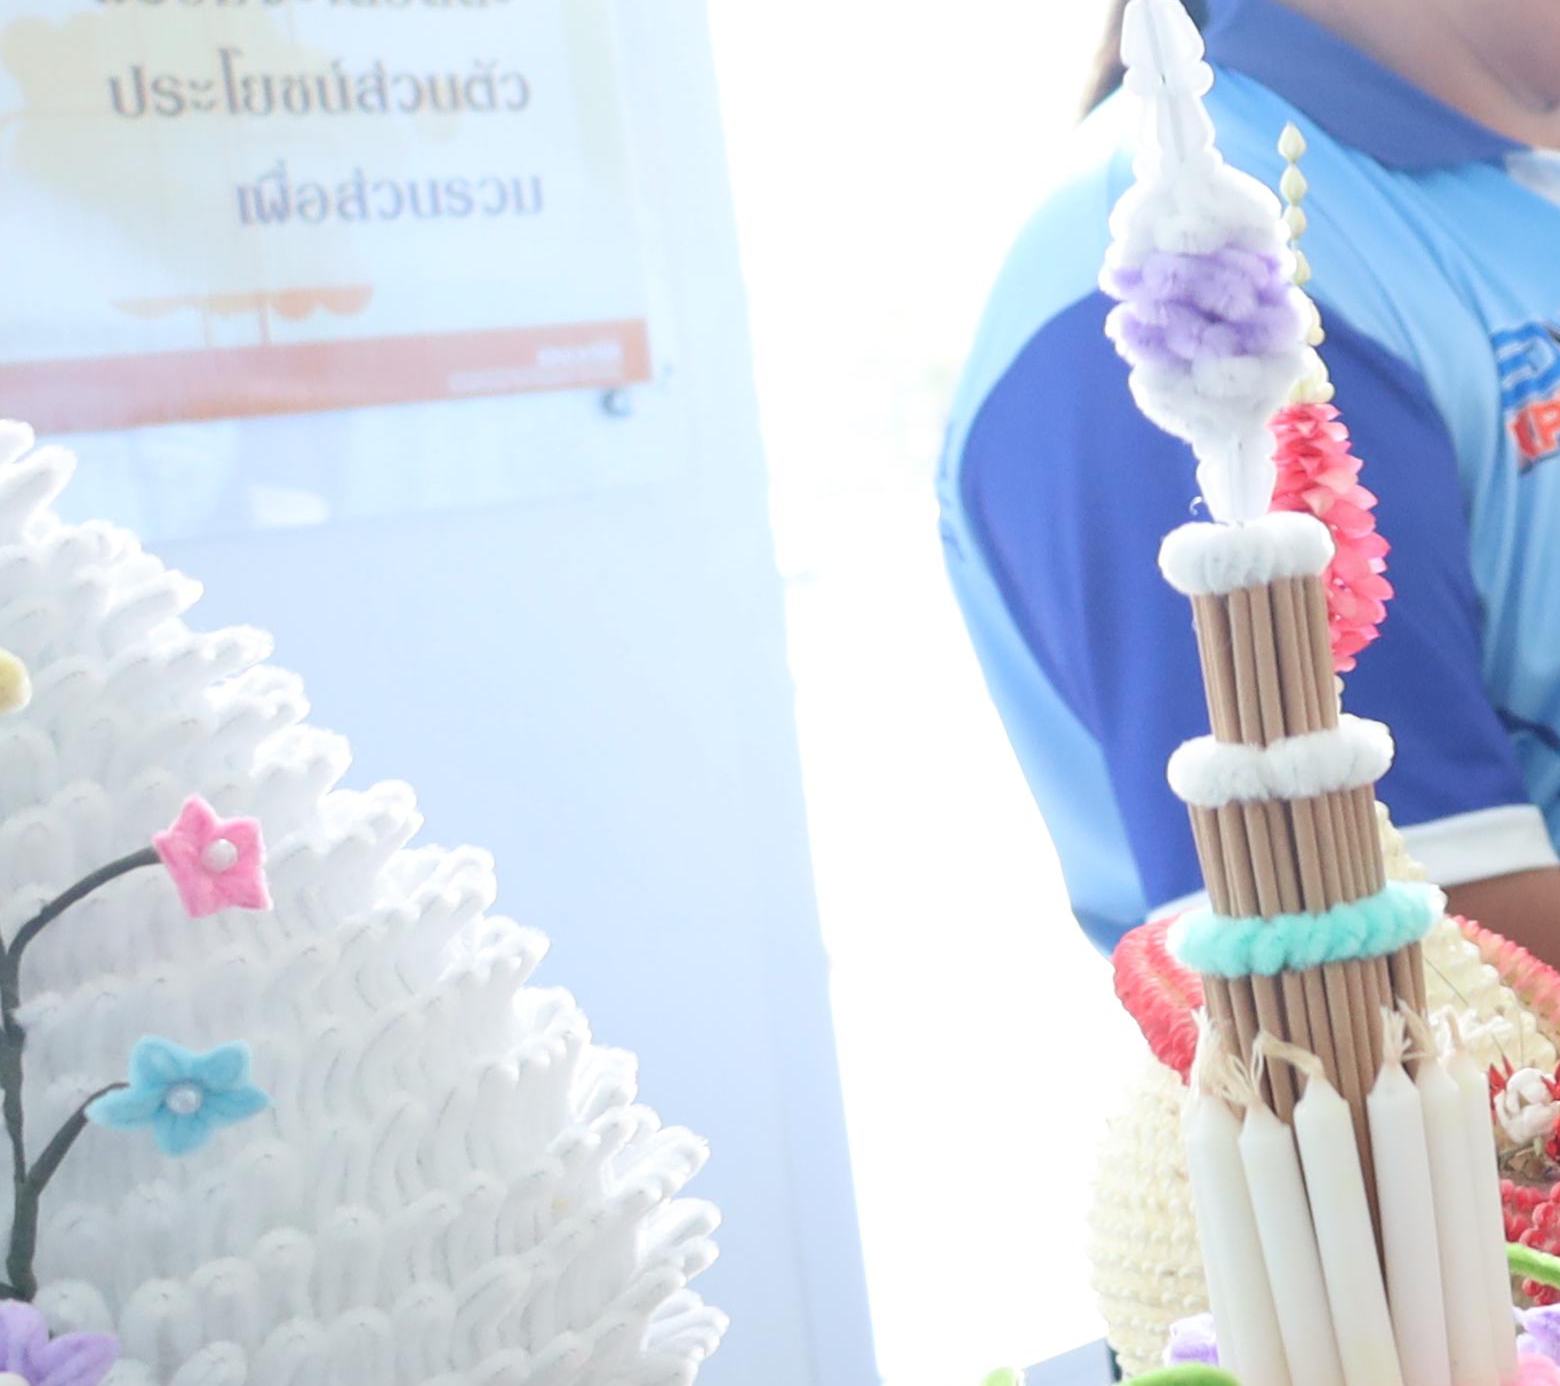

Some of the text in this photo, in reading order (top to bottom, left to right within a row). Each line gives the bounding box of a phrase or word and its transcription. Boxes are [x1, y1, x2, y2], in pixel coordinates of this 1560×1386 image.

[108, 44, 534, 121] ประโยชน์ส่วนตัว
[235, 158, 548, 230] เพื่อส่วนรวม
